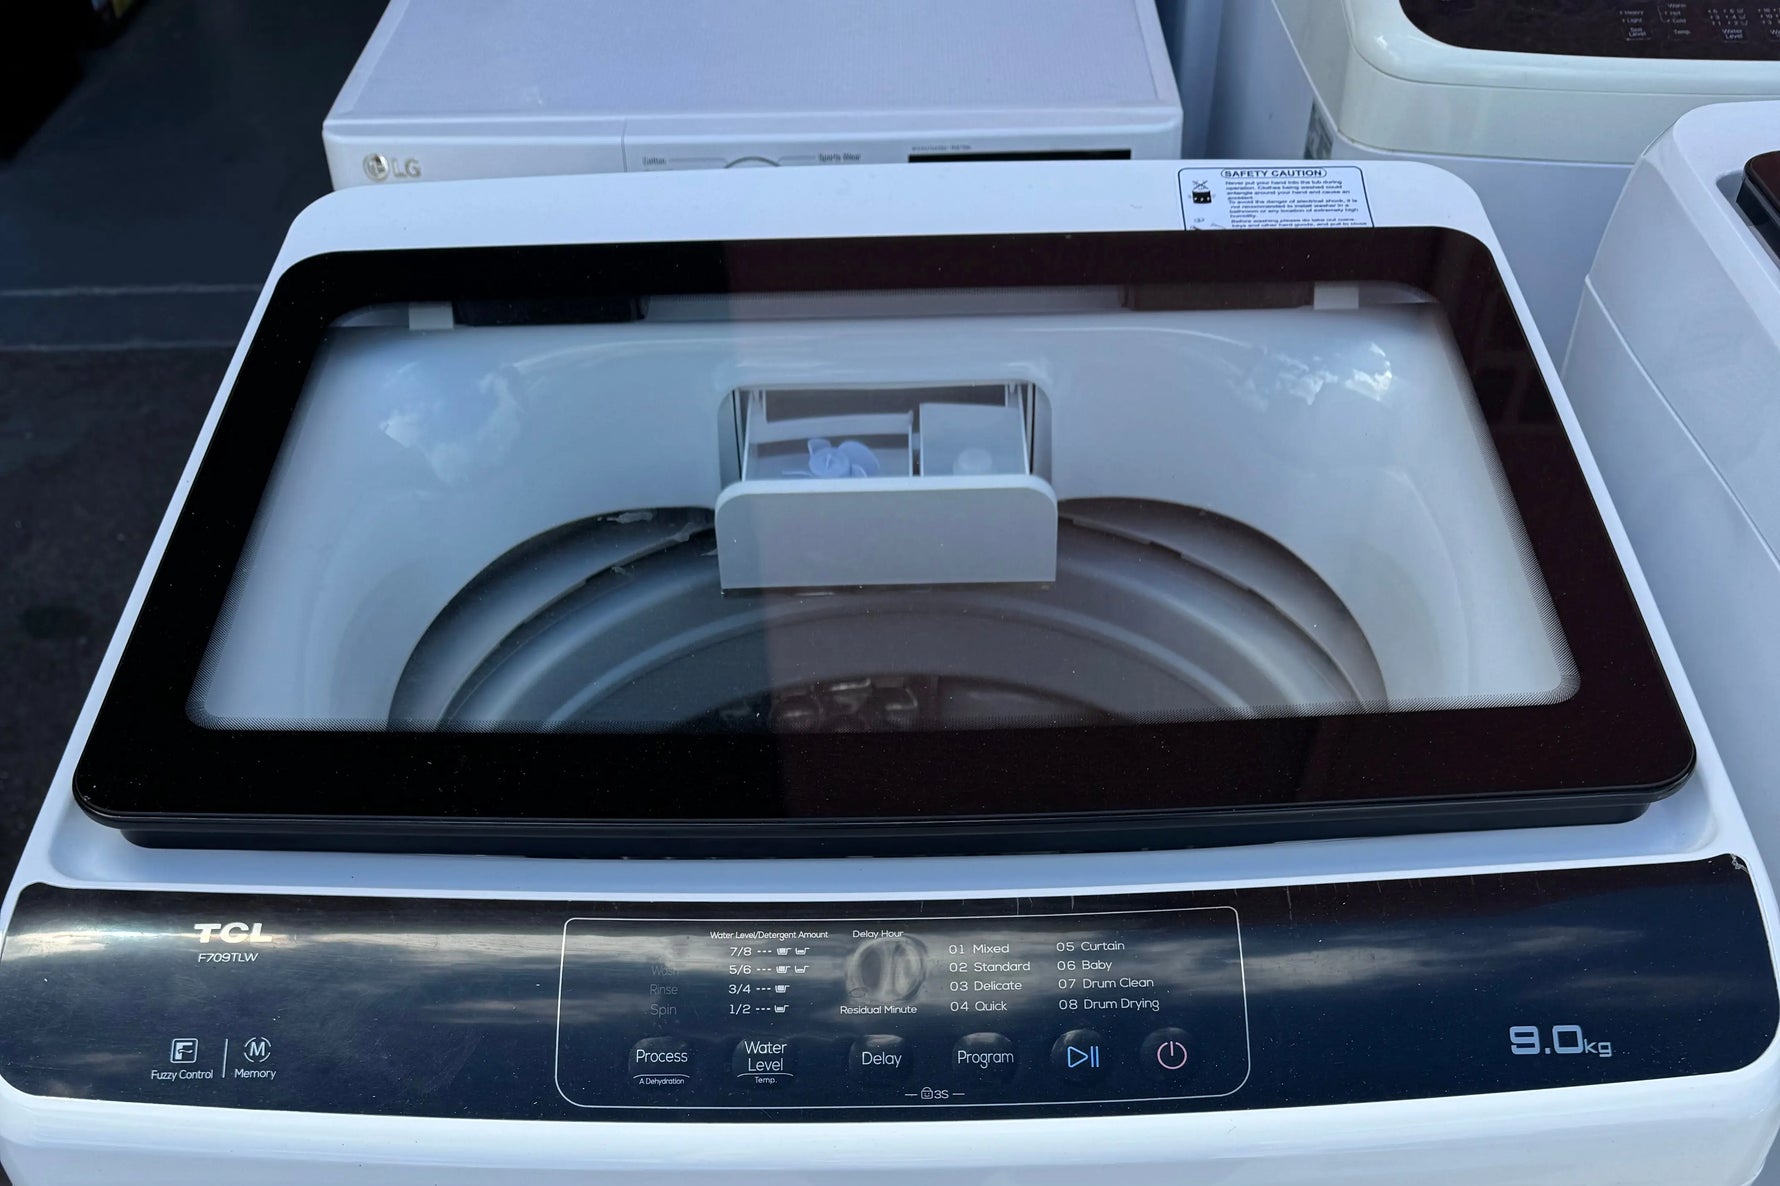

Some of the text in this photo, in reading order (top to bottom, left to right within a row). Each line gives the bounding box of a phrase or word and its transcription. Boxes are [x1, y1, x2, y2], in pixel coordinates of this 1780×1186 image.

[391, 158, 422, 178] LG
[193, 922, 273, 944] TCL
[710, 930, 829, 940] Water Level/Detergent Amount
[853, 929, 905, 939] Delay Hour
[730, 946, 752, 957] 7/8
[948, 942, 1010, 954] 01 Mixed
[1056, 940, 1126, 952] 05 Curtain
[197, 952, 260, 962] F709TLW
[728, 964, 752, 975] 5/6
[948, 961, 1031, 973] 02 Standard
[1056, 959, 1113, 972] 06 Baby
[650, 983, 679, 995] Rinse
[728, 984, 752, 994] 3/4
[950, 980, 1022, 992] 03 Delicate
[1058, 976, 1154, 990] 07 Drum Clean
[650, 1003, 677, 1018] Spin
[729, 1003, 751, 1014] 1/2
[840, 1004, 918, 1014] Residual Minute
[950, 1000, 1008, 1012] 04 Quick
[1058, 997, 1160, 1012] 08 Drum Drying
[744, 1041, 788, 1055] Water
[636, 1049, 689, 1064] Process
[862, 1052, 903, 1068] Delay
[957, 1051, 1014, 1069] Program
[748, 1058, 784, 1072] Level
[150, 1069, 214, 1082] Fuzzy Control
[234, 1068, 277, 1080] Memory
[645, 1077, 686, 1086] Dehydration
[934, 1090, 950, 1099] 3S
